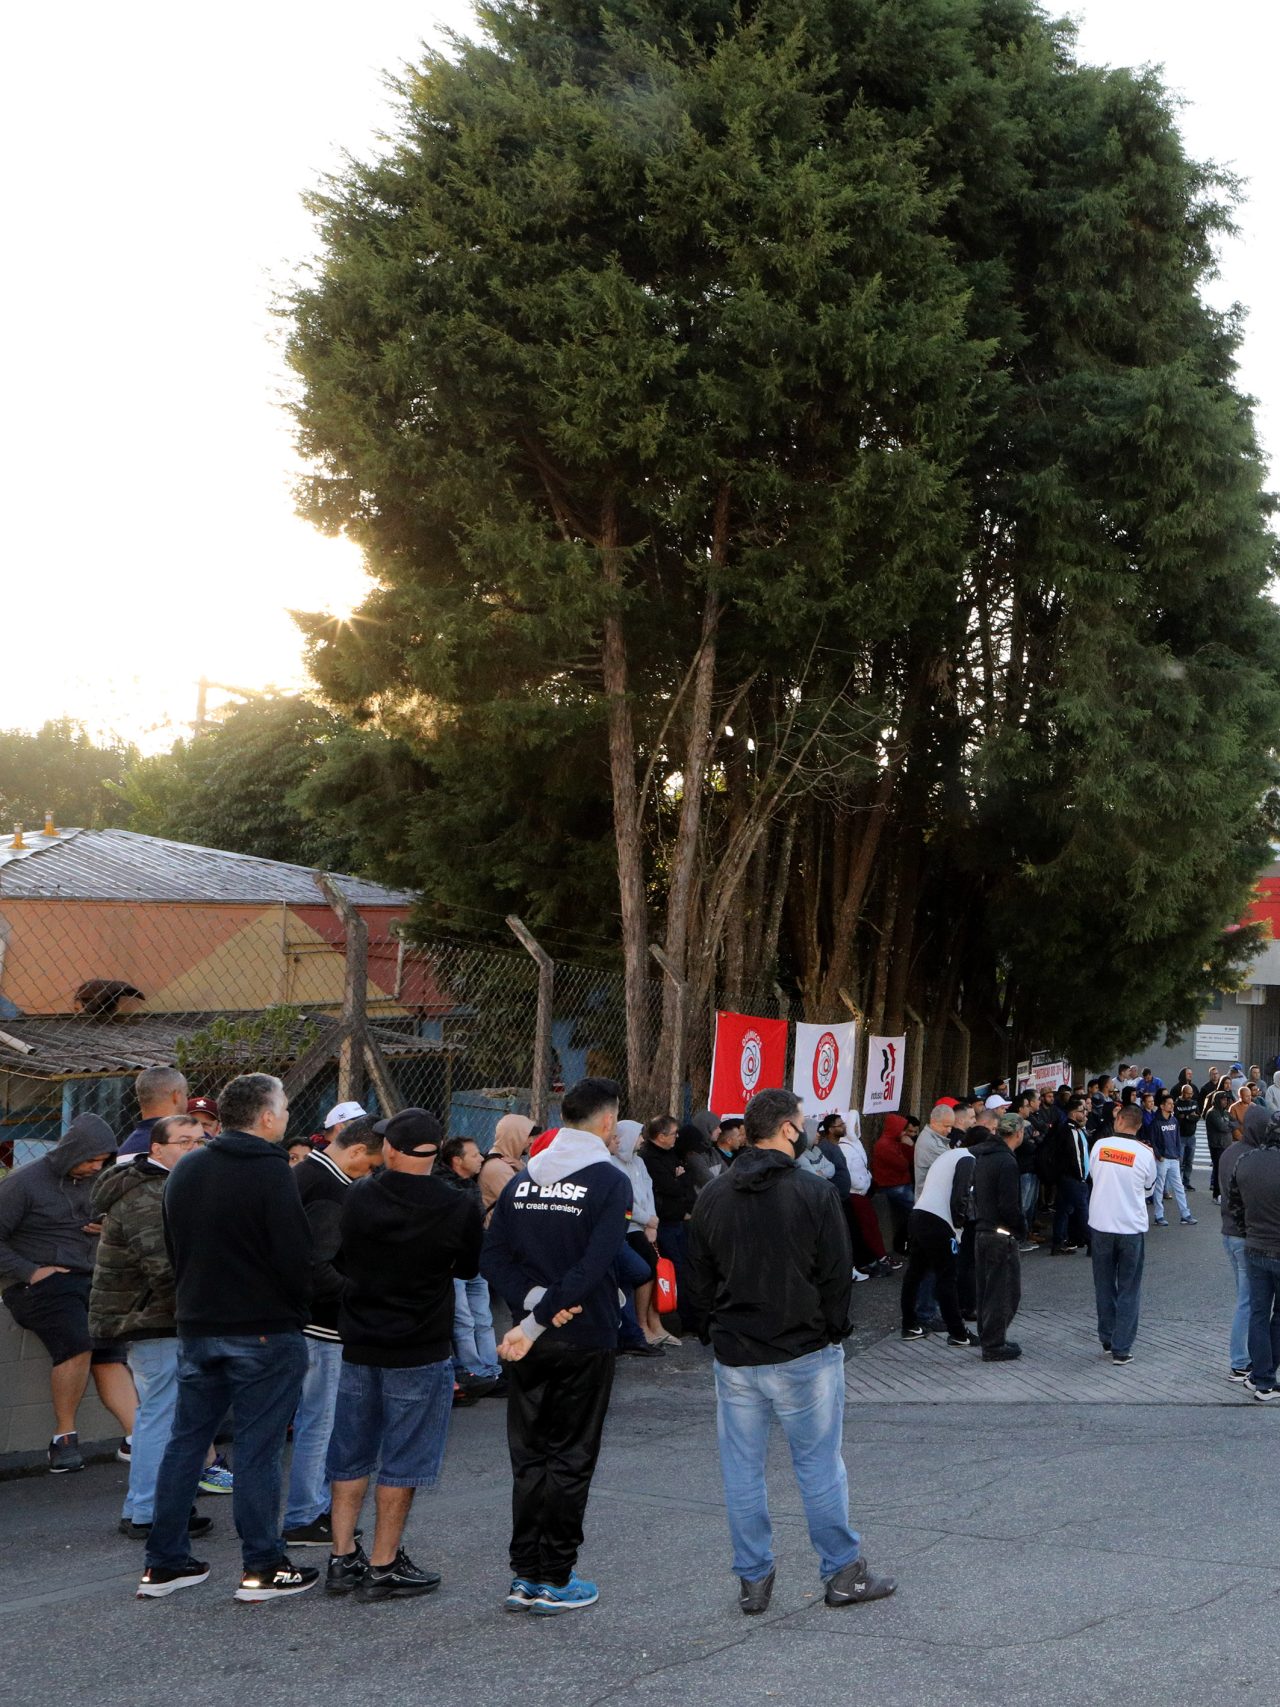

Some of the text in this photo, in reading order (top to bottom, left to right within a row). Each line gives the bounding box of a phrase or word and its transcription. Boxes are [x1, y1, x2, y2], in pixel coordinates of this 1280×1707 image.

[1103, 1150, 1133, 1163] Suvinil
[540, 1182, 588, 1201] BASF
[273, 1571, 303, 1584] FILA
